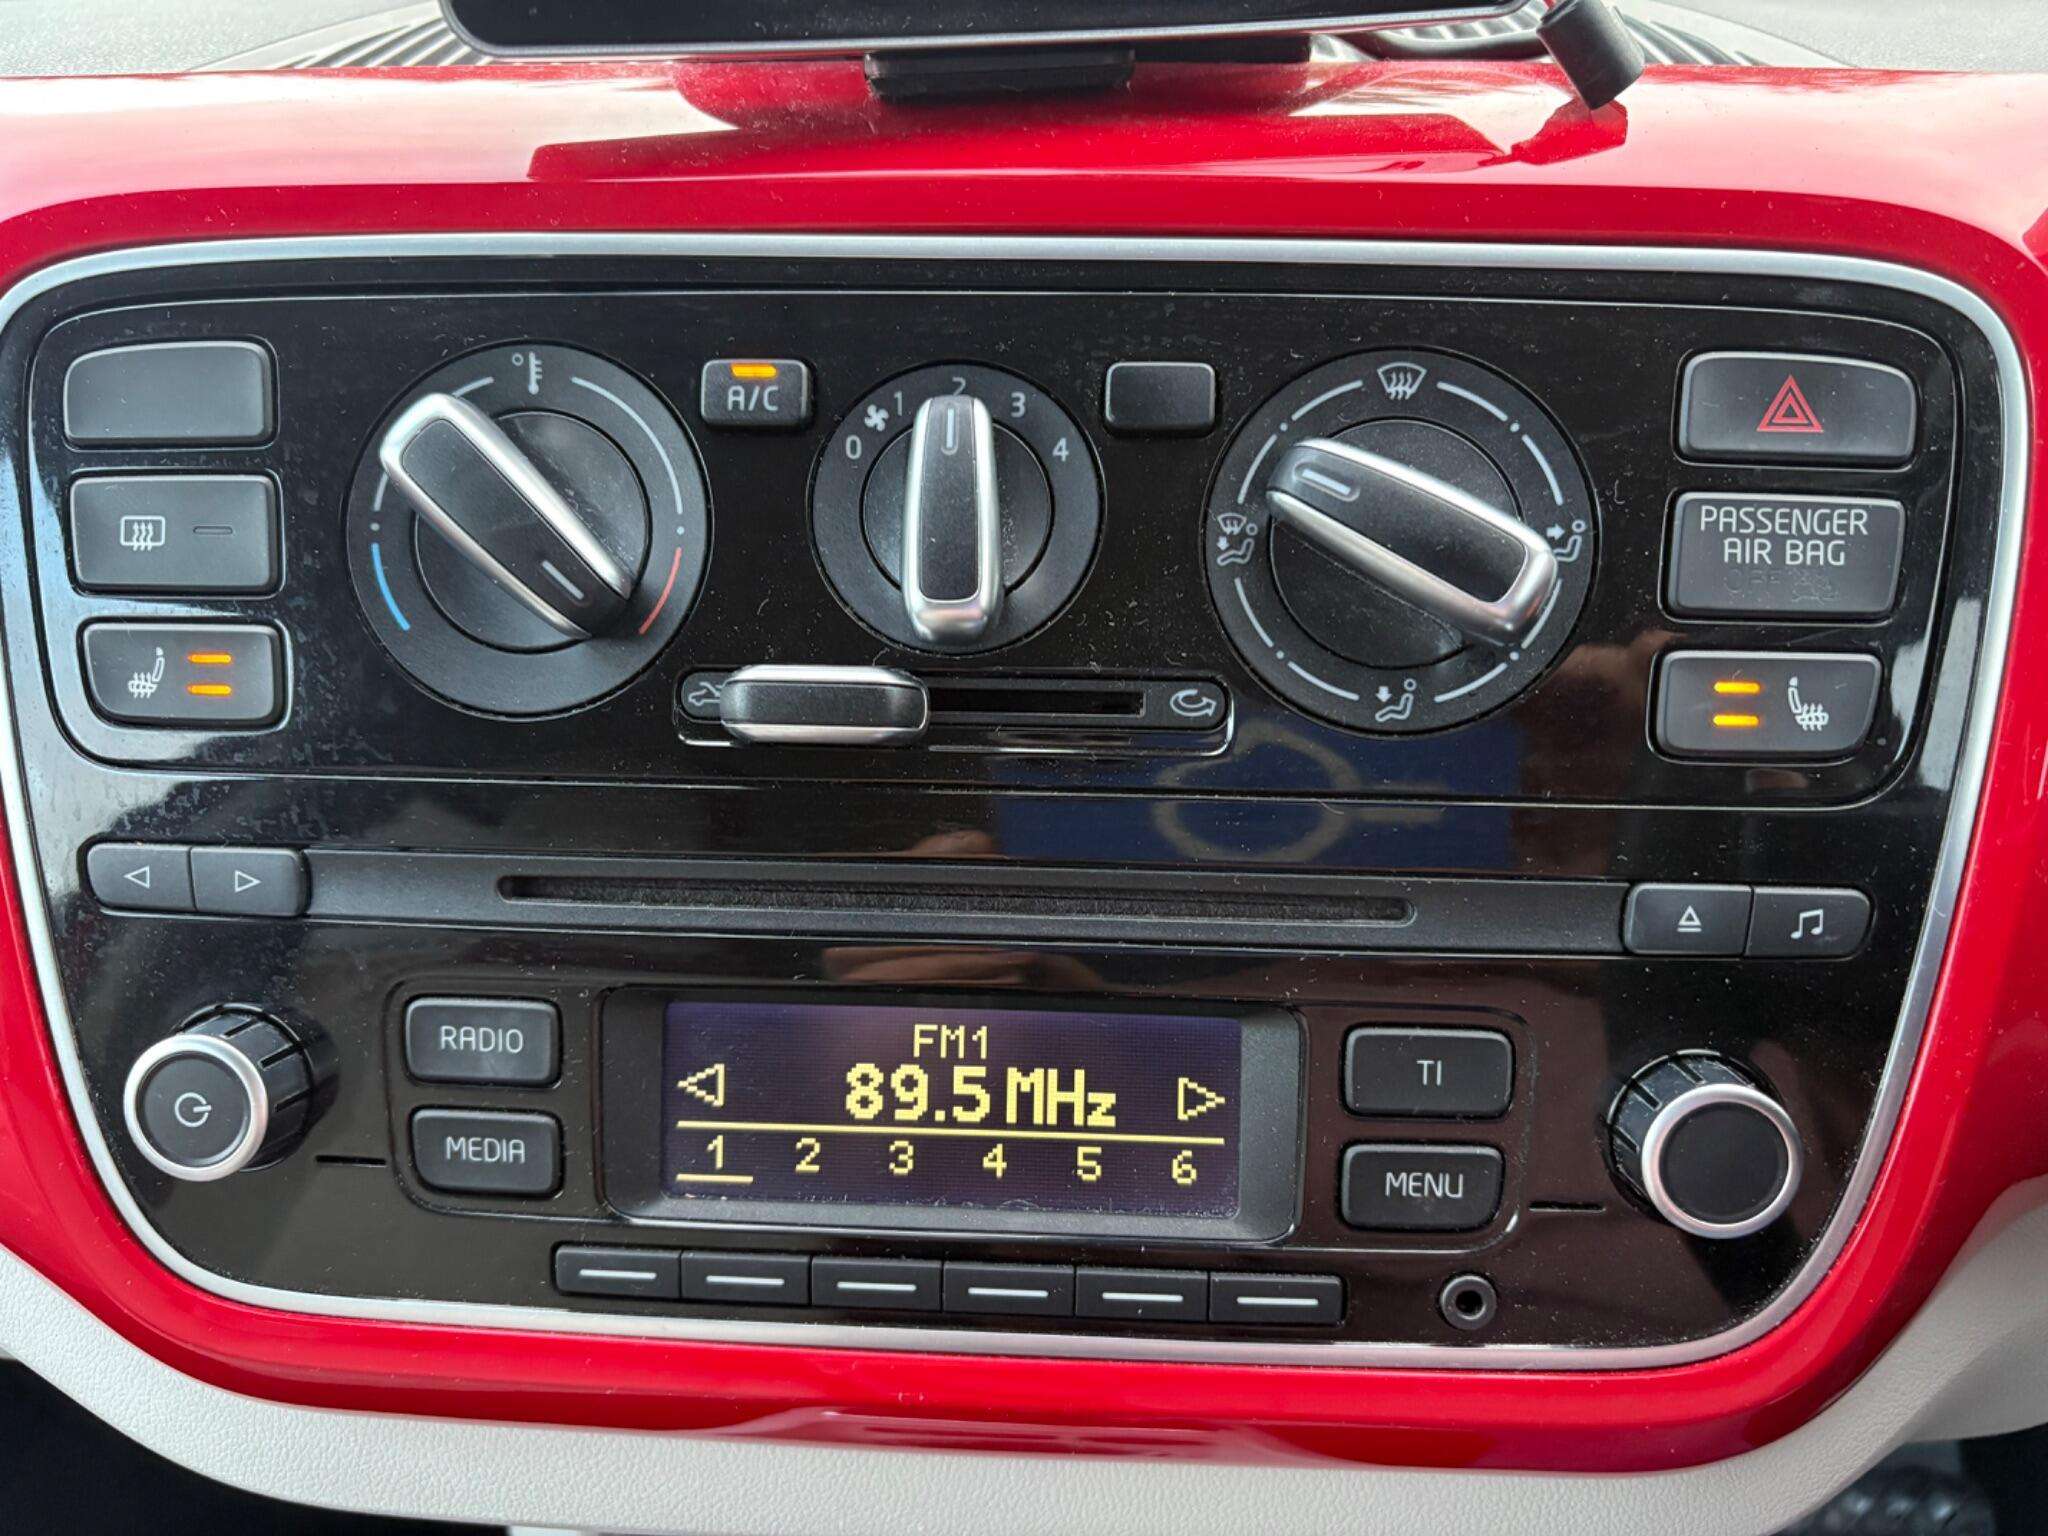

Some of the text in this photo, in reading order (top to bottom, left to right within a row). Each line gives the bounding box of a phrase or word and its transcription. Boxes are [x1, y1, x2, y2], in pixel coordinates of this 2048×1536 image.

[727, 384, 779, 412] A/C
[845, 376, 1070, 462] 0 1 2 3 4
[1700, 505, 1868, 536] PASSENGER
[1723, 537, 1846, 566] AIR BAG
[440, 1025, 524, 1054] RADIO
[913, 1023, 988, 1060] FM1
[1416, 1059, 1442, 1086] TI
[845, 1062, 1117, 1127] 89.5 MHz
[445, 1136, 526, 1164] MEDIA
[706, 1134, 1197, 1185] 1 2 3 4 5 6
[1385, 1171, 1464, 1199] MENU
